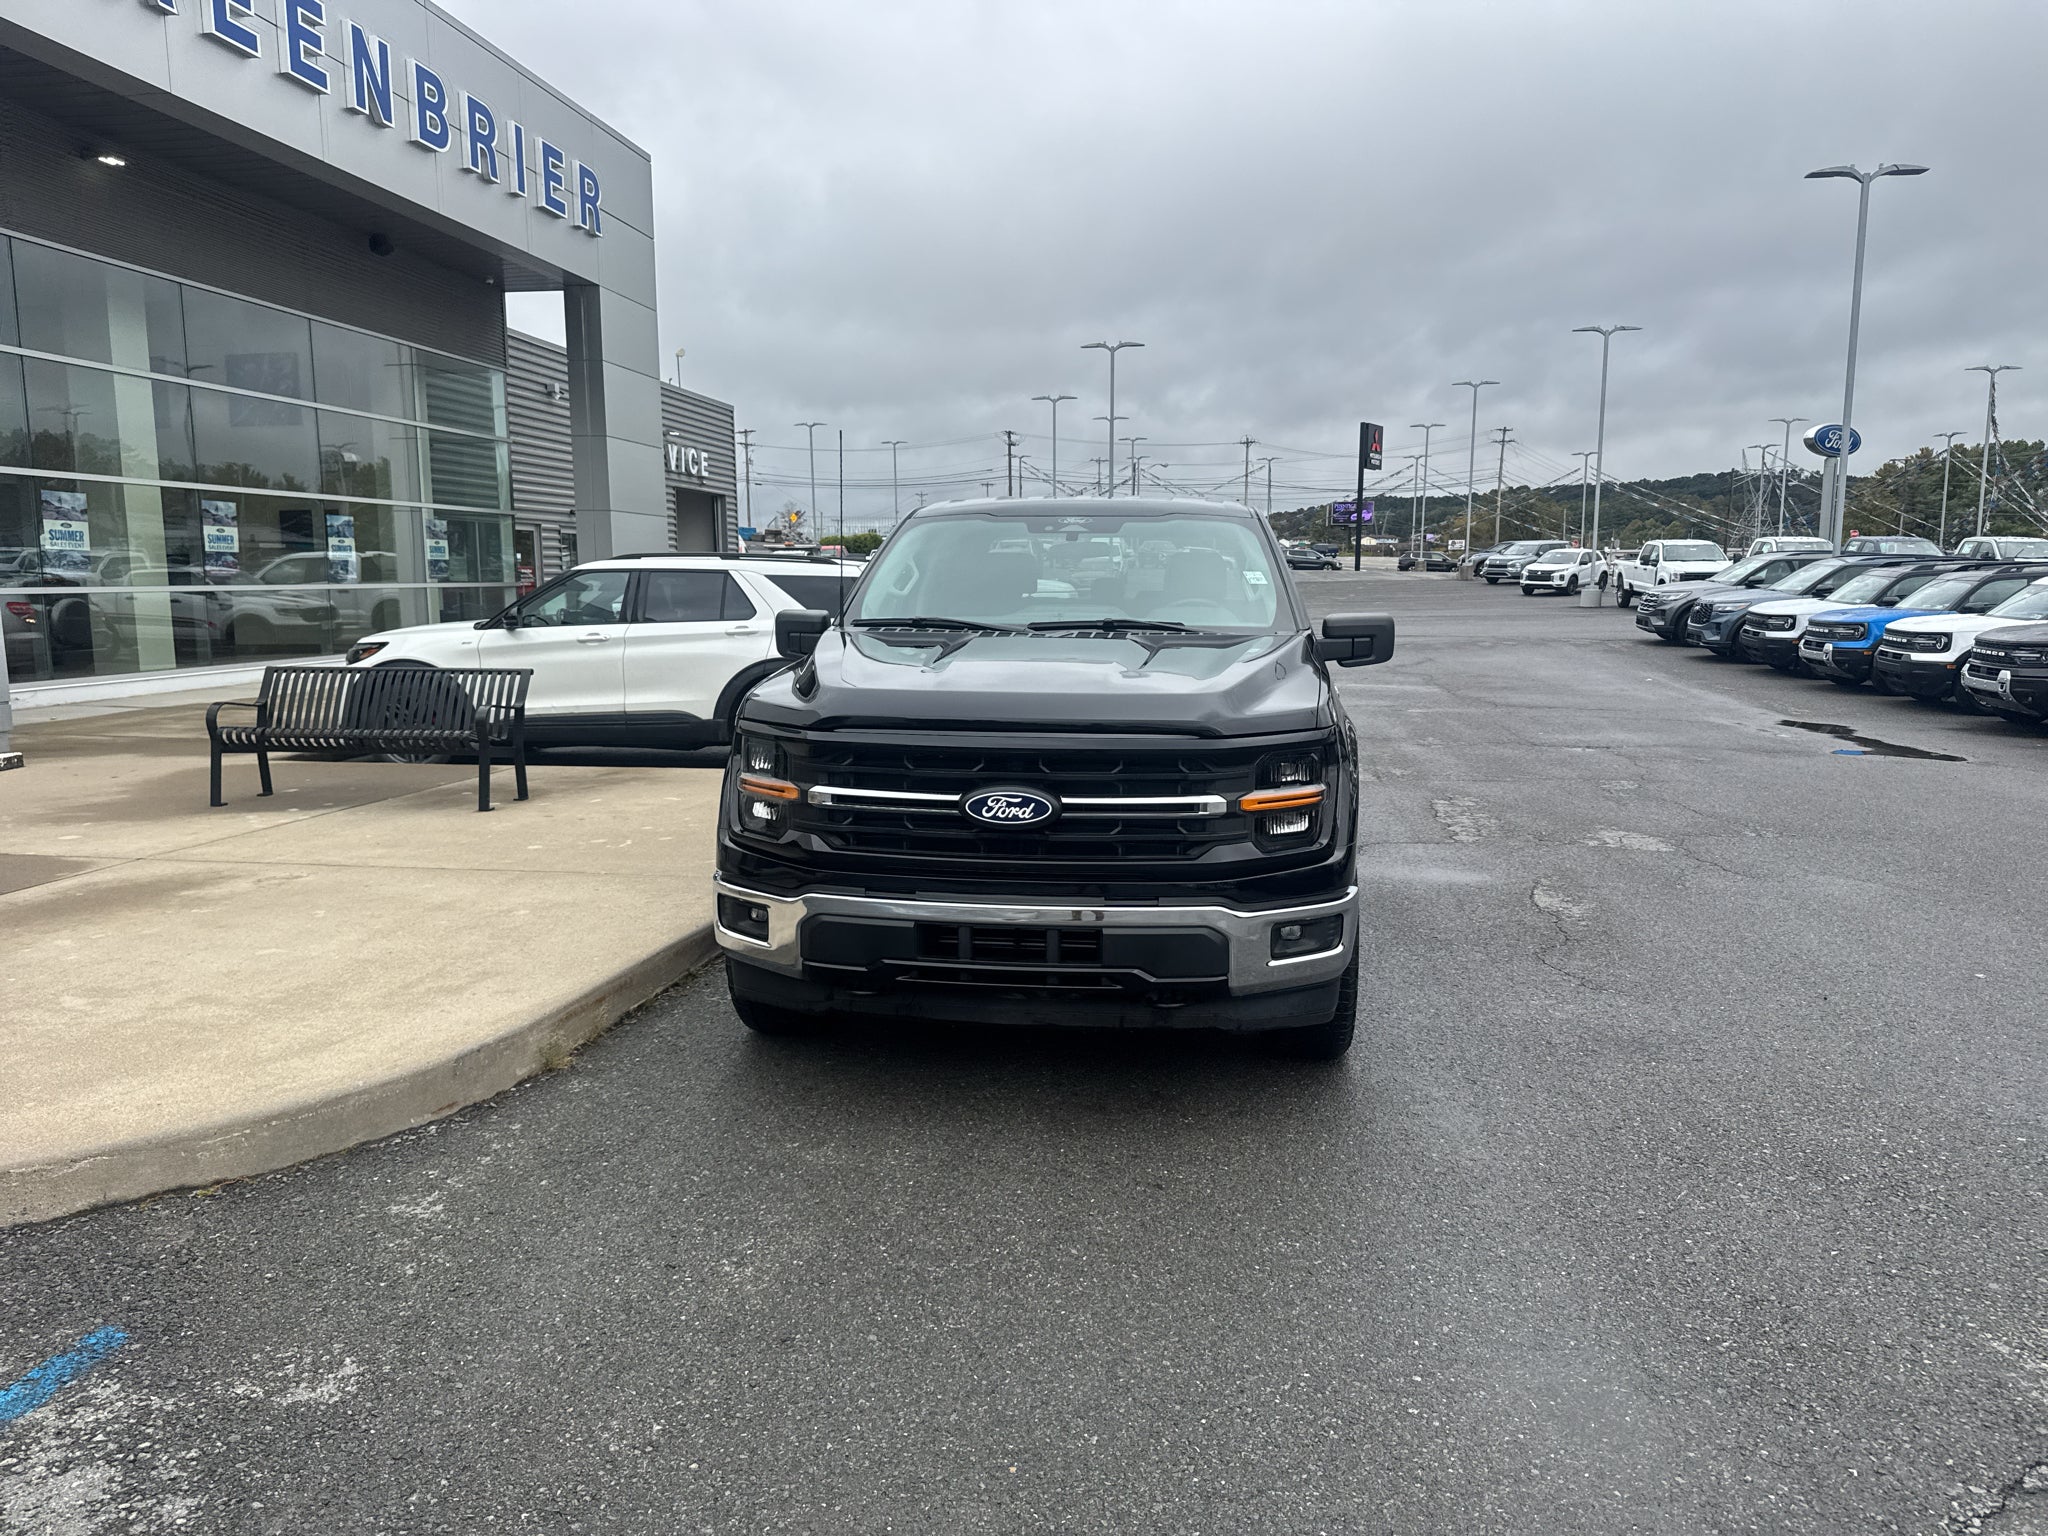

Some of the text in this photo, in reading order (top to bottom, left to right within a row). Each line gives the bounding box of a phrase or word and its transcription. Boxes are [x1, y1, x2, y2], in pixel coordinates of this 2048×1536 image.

[48, 529, 85, 542] SUMMER
[207, 534, 235, 545] SUMMER
[1972, 647, 2006, 657] BRONCO
[981, 796, 1035, 819] Ford
